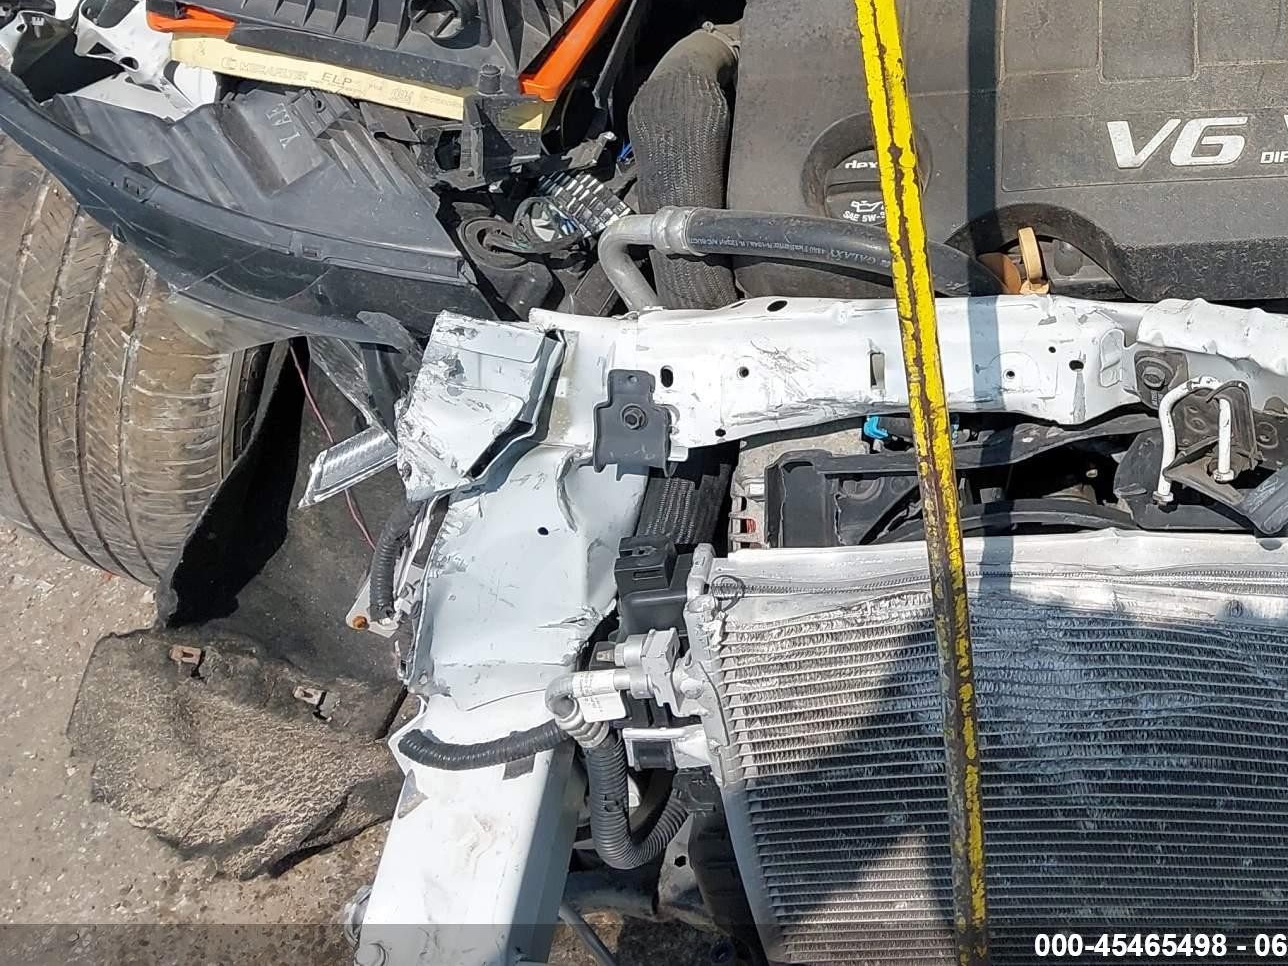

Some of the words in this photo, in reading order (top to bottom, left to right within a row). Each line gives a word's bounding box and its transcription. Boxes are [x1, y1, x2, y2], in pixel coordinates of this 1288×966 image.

[321, 72, 353, 86] ELP
[1106, 116, 1249, 169] V6
[843, 210, 860, 222] SAE
